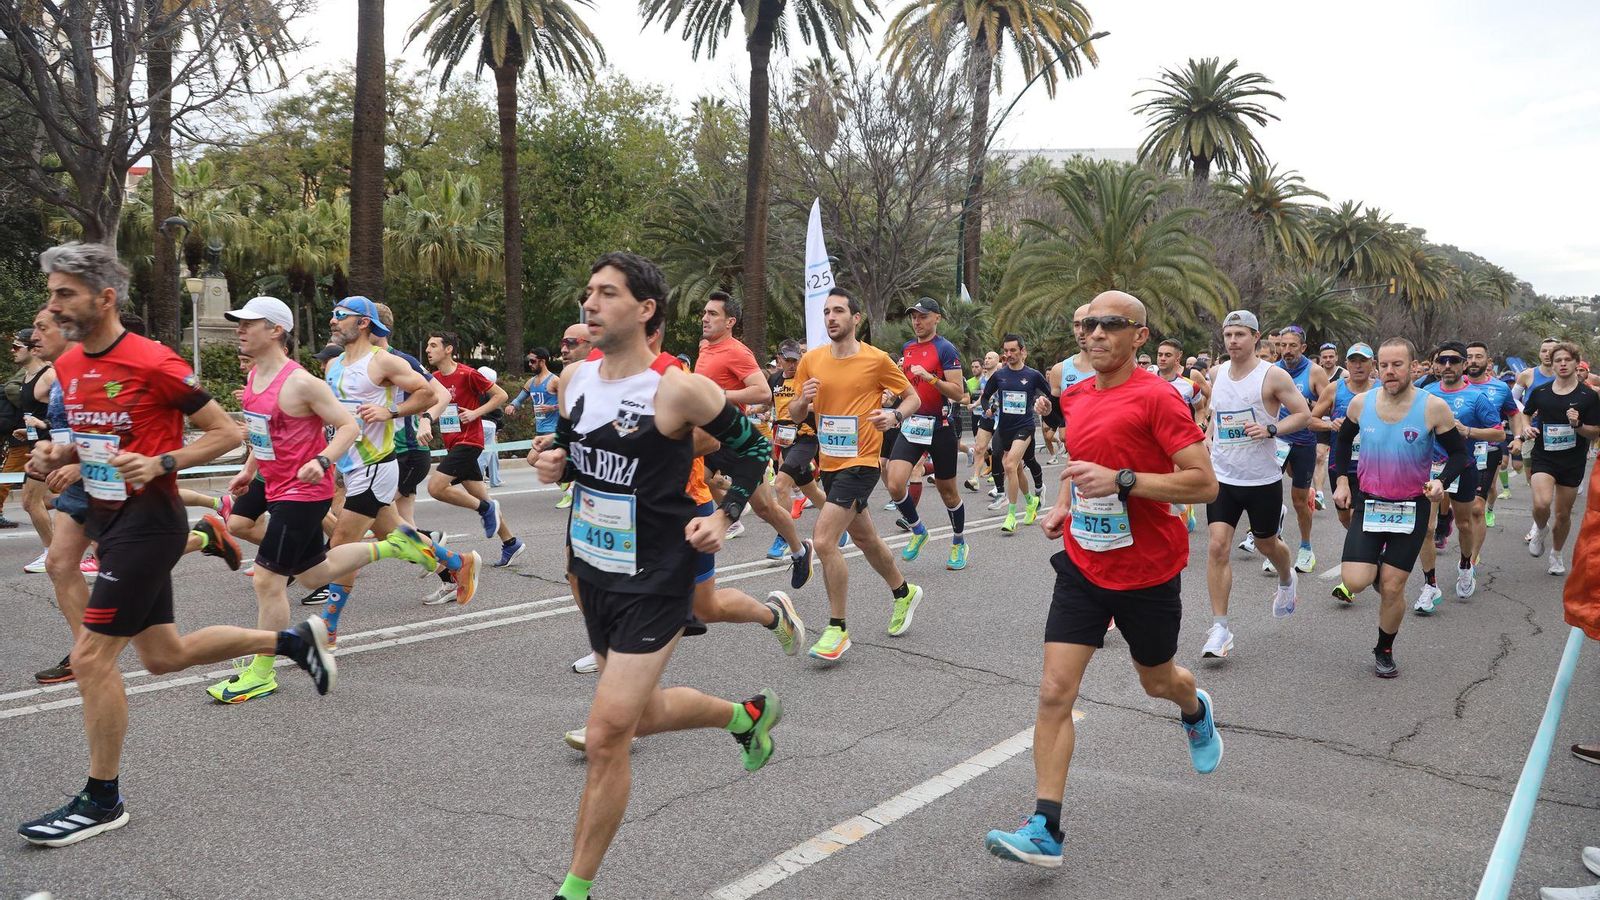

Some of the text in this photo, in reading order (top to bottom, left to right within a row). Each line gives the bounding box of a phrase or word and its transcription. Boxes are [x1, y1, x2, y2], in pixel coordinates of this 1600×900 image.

[910, 427, 926, 436] 657
[827, 435, 847, 446] 517
[1551, 436, 1568, 444] 234
[85, 464, 109, 482] 273
[1379, 513, 1403, 524] 342
[1084, 516, 1112, 534] 575
[586, 527, 615, 550] 419
